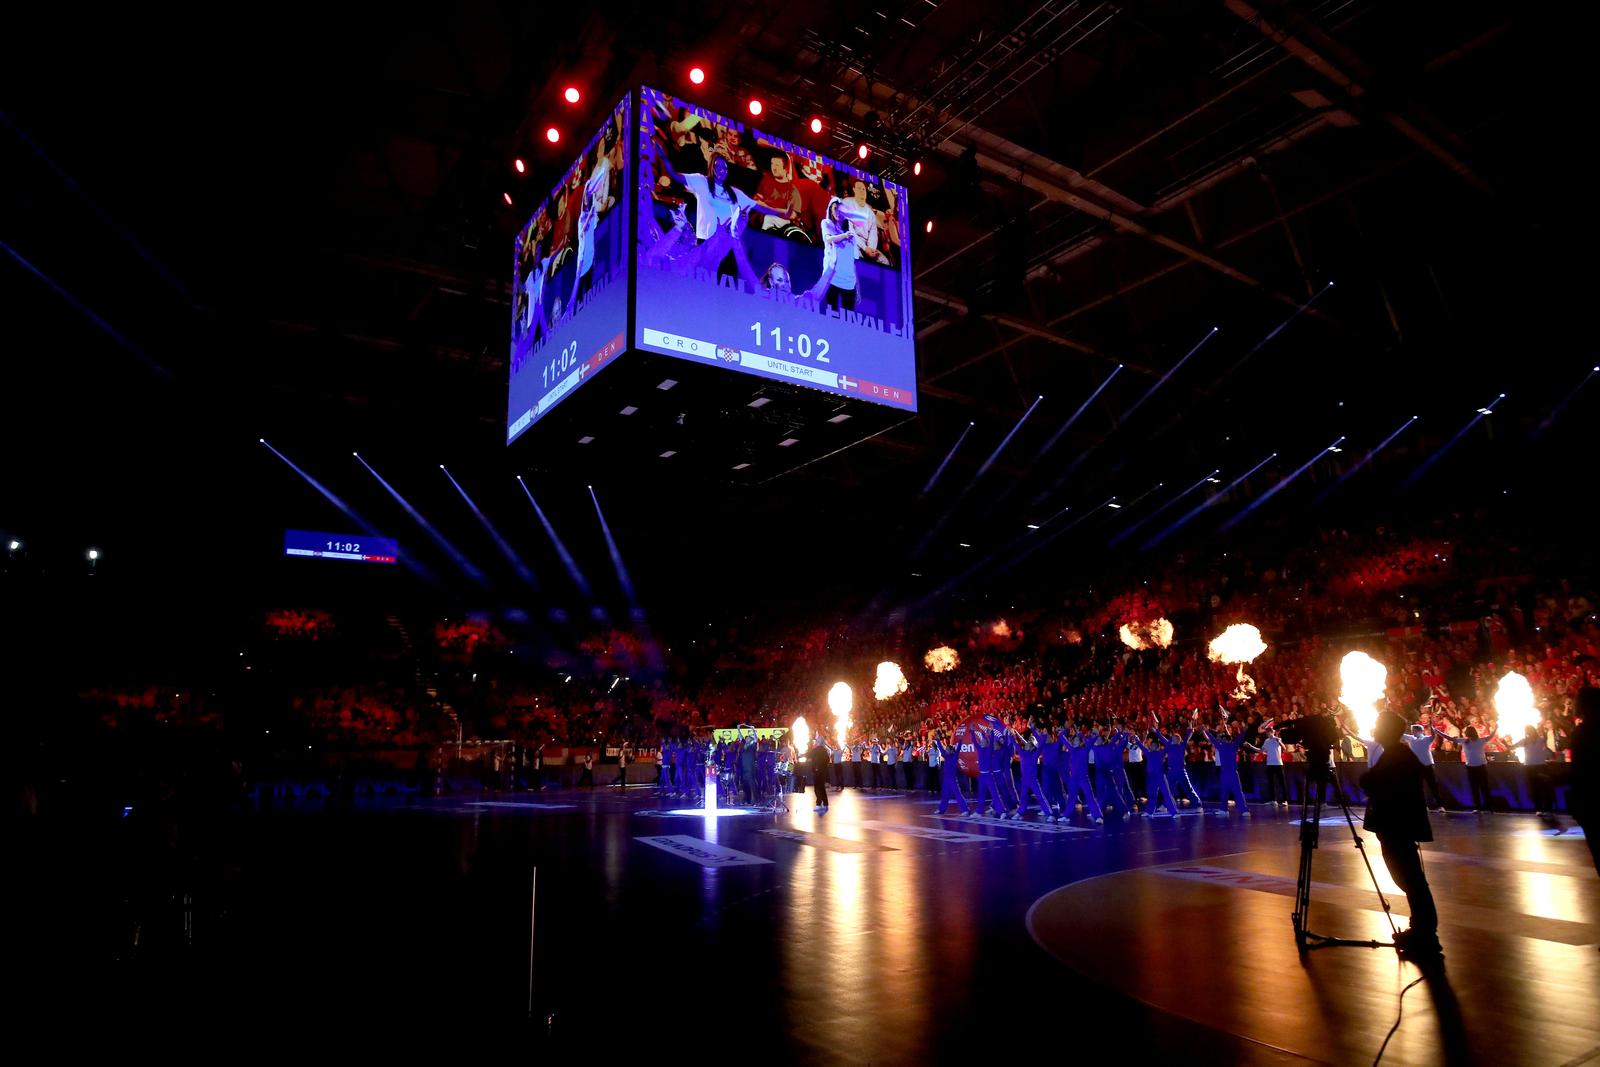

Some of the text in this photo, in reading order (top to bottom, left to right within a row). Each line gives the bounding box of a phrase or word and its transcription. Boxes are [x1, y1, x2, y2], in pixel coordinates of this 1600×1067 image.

[662, 336, 698, 352] CRO
[750, 321, 831, 364] 11:02
[542, 340, 577, 389] 11:02
[767, 360, 814, 378] UNTIL START
[873, 385, 900, 399] DEN
[326, 541, 361, 553] 11:02
